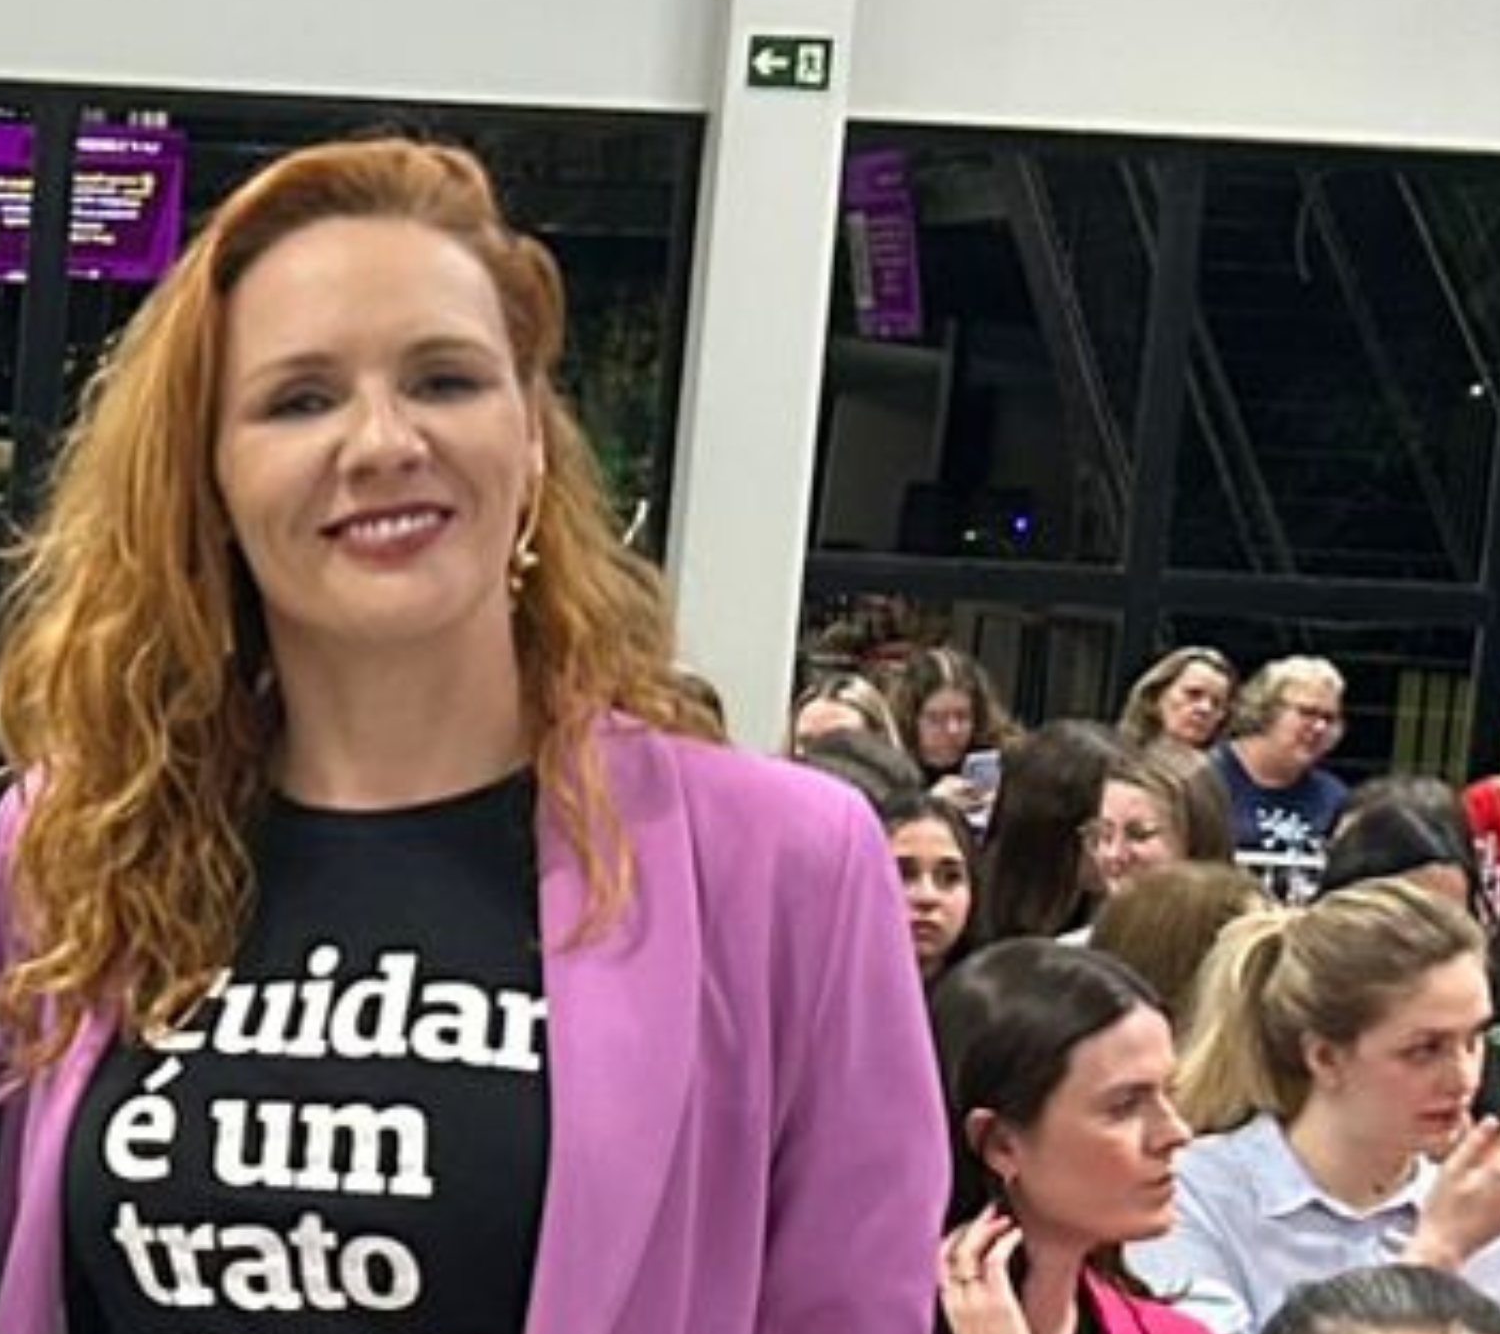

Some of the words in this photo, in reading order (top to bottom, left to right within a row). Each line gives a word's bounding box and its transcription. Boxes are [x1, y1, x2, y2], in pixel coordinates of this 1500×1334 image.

[105, 1057, 182, 1181] é
[211, 1099, 433, 1197] um
[112, 1201, 421, 1311] trato
